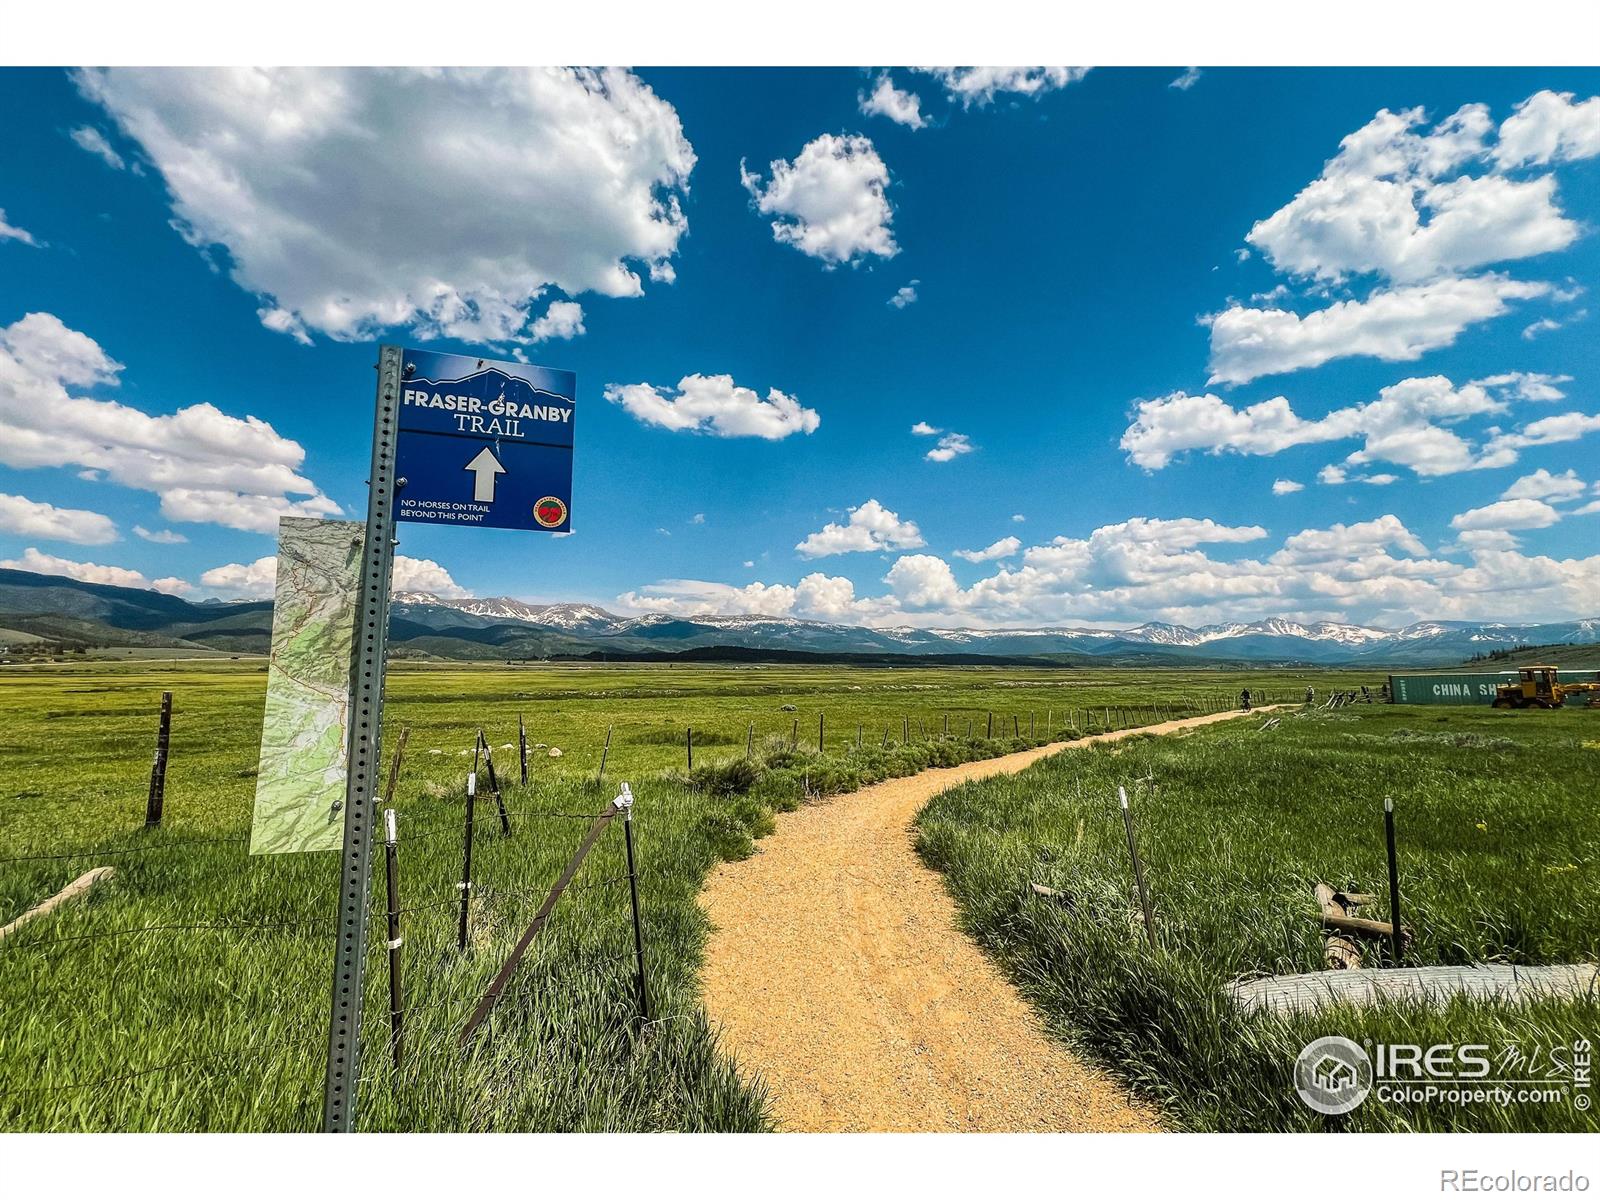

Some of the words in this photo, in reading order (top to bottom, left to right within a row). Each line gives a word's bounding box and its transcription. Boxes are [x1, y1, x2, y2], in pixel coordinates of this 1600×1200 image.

[403, 389, 572, 423] FRASER-GRANBY
[453, 413, 525, 437] TRAIL
[401, 499, 416, 507] NO
[418, 501, 450, 510] HORSES
[452, 503, 467, 511] ON
[467, 504, 490, 513] TRAIL
[400, 509, 436, 519] BEYOND
[437, 511, 456, 520] THIS
[457, 513, 484, 521] POINT
[1432, 683, 1471, 696] CHINA
[1479, 683, 1498, 696] SH
